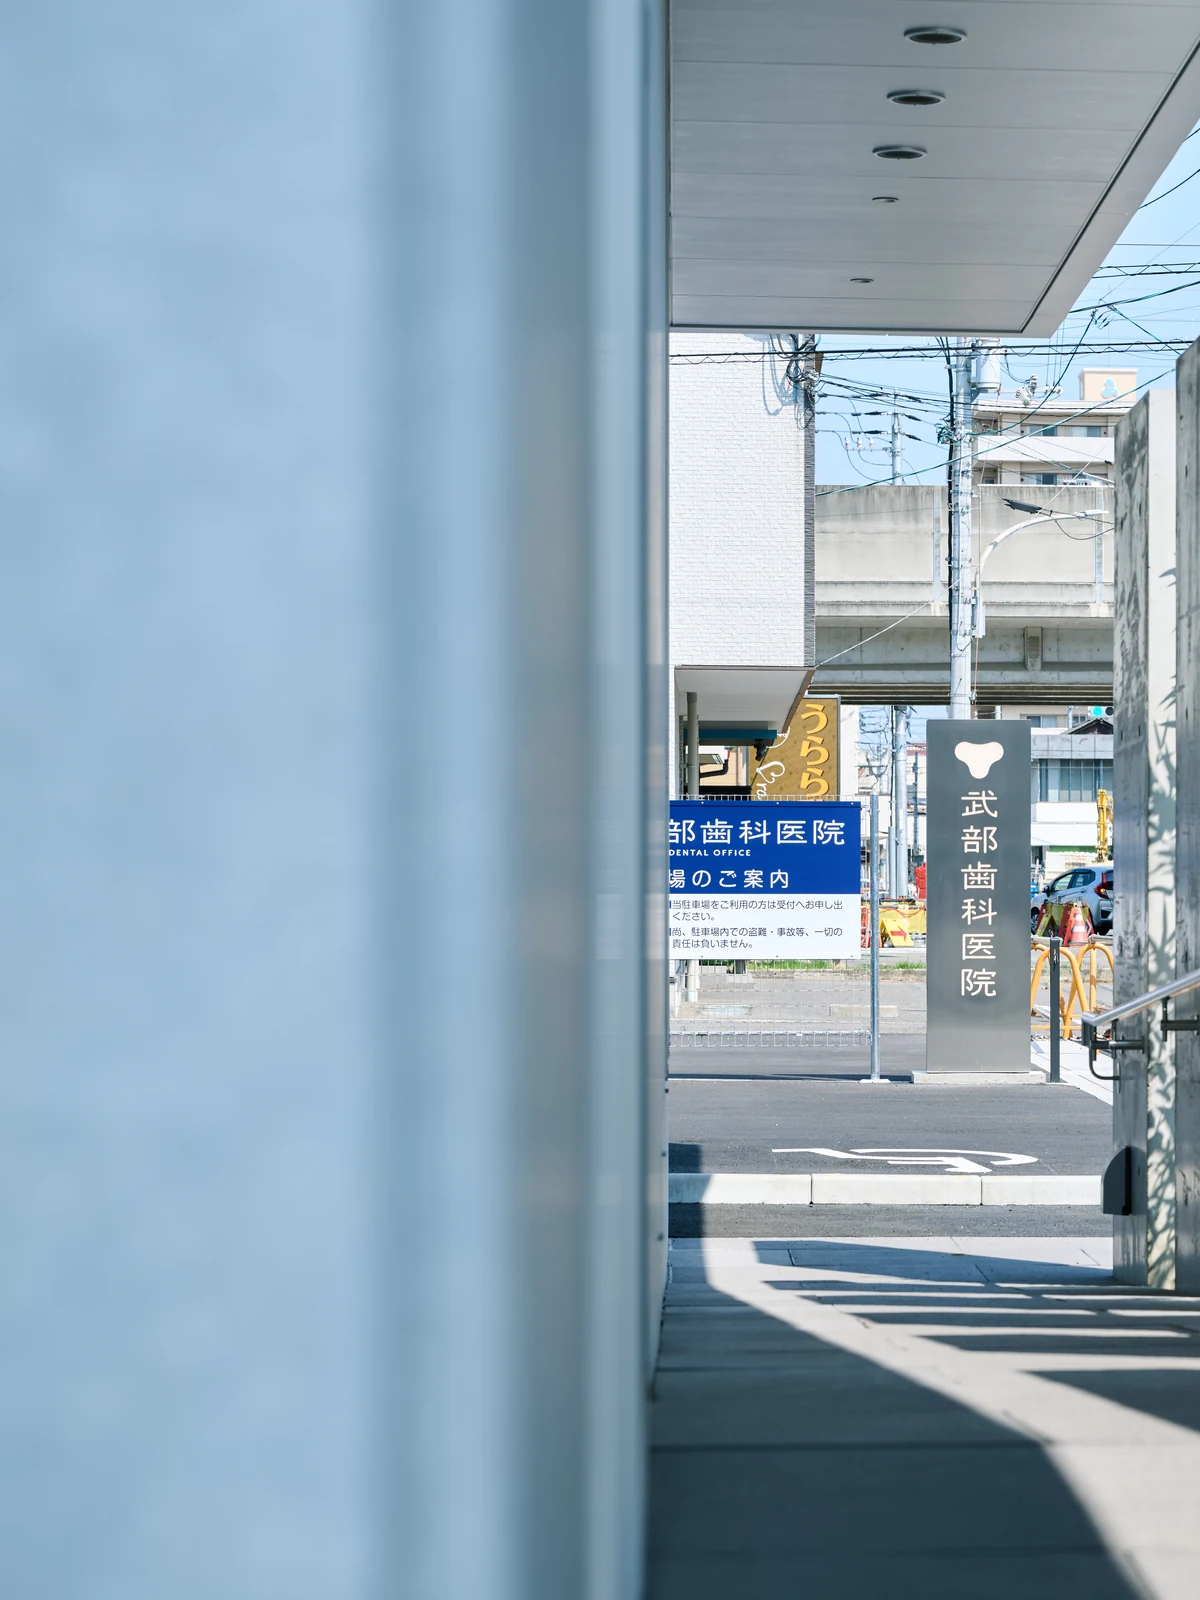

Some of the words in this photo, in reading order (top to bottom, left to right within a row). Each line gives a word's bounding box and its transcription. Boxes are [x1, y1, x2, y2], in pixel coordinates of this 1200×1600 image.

[800, 703, 829, 801] うらら
[669, 818, 845, 845] 部歯科医院
[669, 849, 708, 857] DENTAL
[713, 849, 751, 857] OFFICE
[669, 868, 789, 889] 場のご案内
[960, 789, 998, 997] 武部歯科医院
[672, 900, 843, 910] 当駐車場をご利用の方は受付へお申し出
[672, 911, 715, 921] ください。
[672, 939, 753, 949] 責任は負いません。
